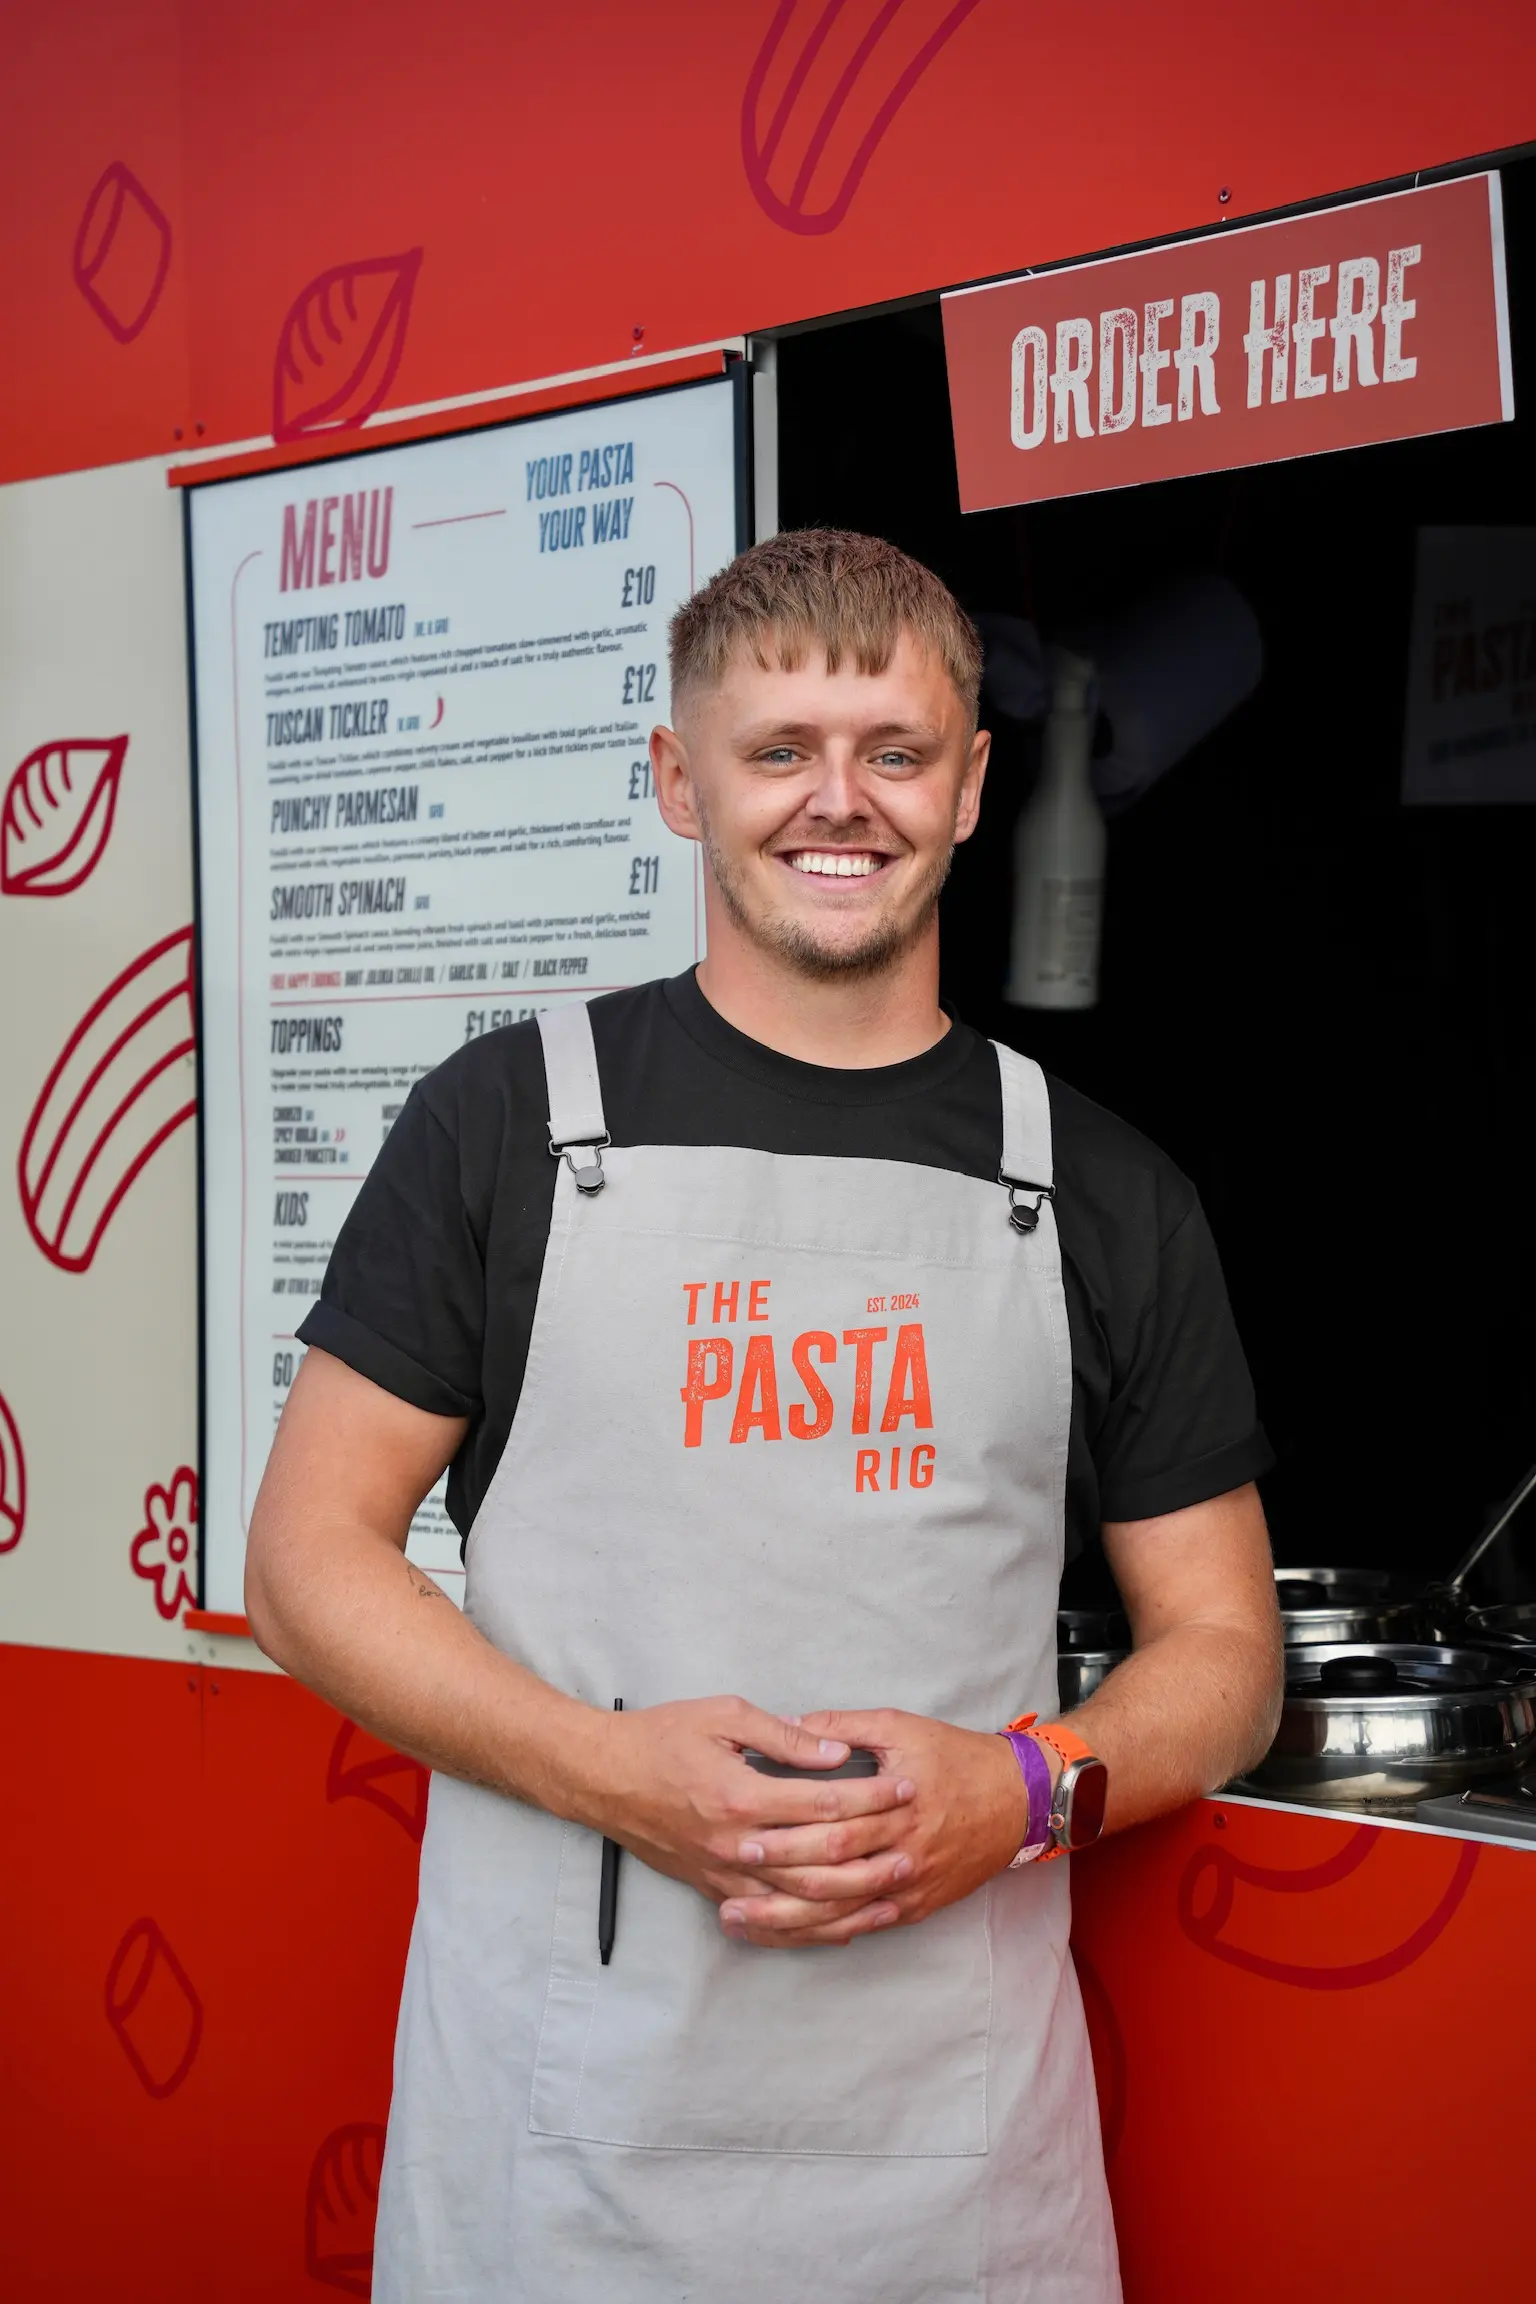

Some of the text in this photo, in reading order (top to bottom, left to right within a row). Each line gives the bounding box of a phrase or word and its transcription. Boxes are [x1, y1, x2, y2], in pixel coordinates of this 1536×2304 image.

[1010, 243, 1422, 450] ORDER HERE
[526, 442, 635, 502] YOUR PASTA
[279, 486, 394, 593] MENU
[539, 497, 635, 553] YOUR WAY
[621, 565, 656, 608] £10
[263, 613, 338, 659] TEMPTING
[344, 604, 406, 648] TOMATO
[574, 630, 589, 642] with
[591, 627, 614, 641] garlic,
[614, 622, 648, 636] aromatic
[459, 662, 472, 673] and
[560, 645, 596, 658] authentic
[596, 640, 623, 654] flavour.
[622, 663, 657, 705] £12
[266, 698, 389, 747] TUSCAN TICKLER
[475, 736, 510, 750] vegetable
[511, 732, 540, 744] bouillon
[542, 730, 558, 740] with
[577, 725, 598, 739] garlic
[599, 724, 613, 734] and
[615, 720, 639, 733] Italian
[533, 746, 548, 757] kick
[549, 744, 564, 755] that
[590, 741, 606, 752] your
[607, 738, 627, 748] taste
[628, 761, 657, 800] £1
[271, 785, 419, 834] PUNCHY PARMESAN
[492, 829, 506, 839] and
[507, 826, 529, 839] garlic,
[530, 823, 565, 835] thickened
[566, 821, 581, 832] with
[583, 818, 616, 830] cornflour
[617, 817, 632, 827] and
[500, 843, 513, 853] and
[528, 840, 539, 851] for
[562, 835, 603, 849] comforting
[603, 833, 631, 844] flavour.
[629, 856, 659, 895] £11
[270, 876, 406, 921] SMOOTH SPINACH
[526, 918, 542, 928] with
[543, 917, 579, 928] parmesan
[580, 914, 594, 925] and
[595, 913, 618, 926] garlic,
[619, 910, 651, 922] enriched
[555, 932, 566, 941] for
[595, 928, 628, 939] delicious
[501, 960, 519, 979] SALT
[533, 959, 558, 977] BLACK
[558, 957, 589, 976] PEPPER
[271, 1017, 343, 1054] TOPPINGS
[274, 1191, 309, 1227] KIDS
[682, 1280, 772, 1325] THE
[867, 1293, 920, 1313] EST. 2024
[680, 1324, 934, 1447] PASTA
[856, 1444, 936, 1492] RIG
